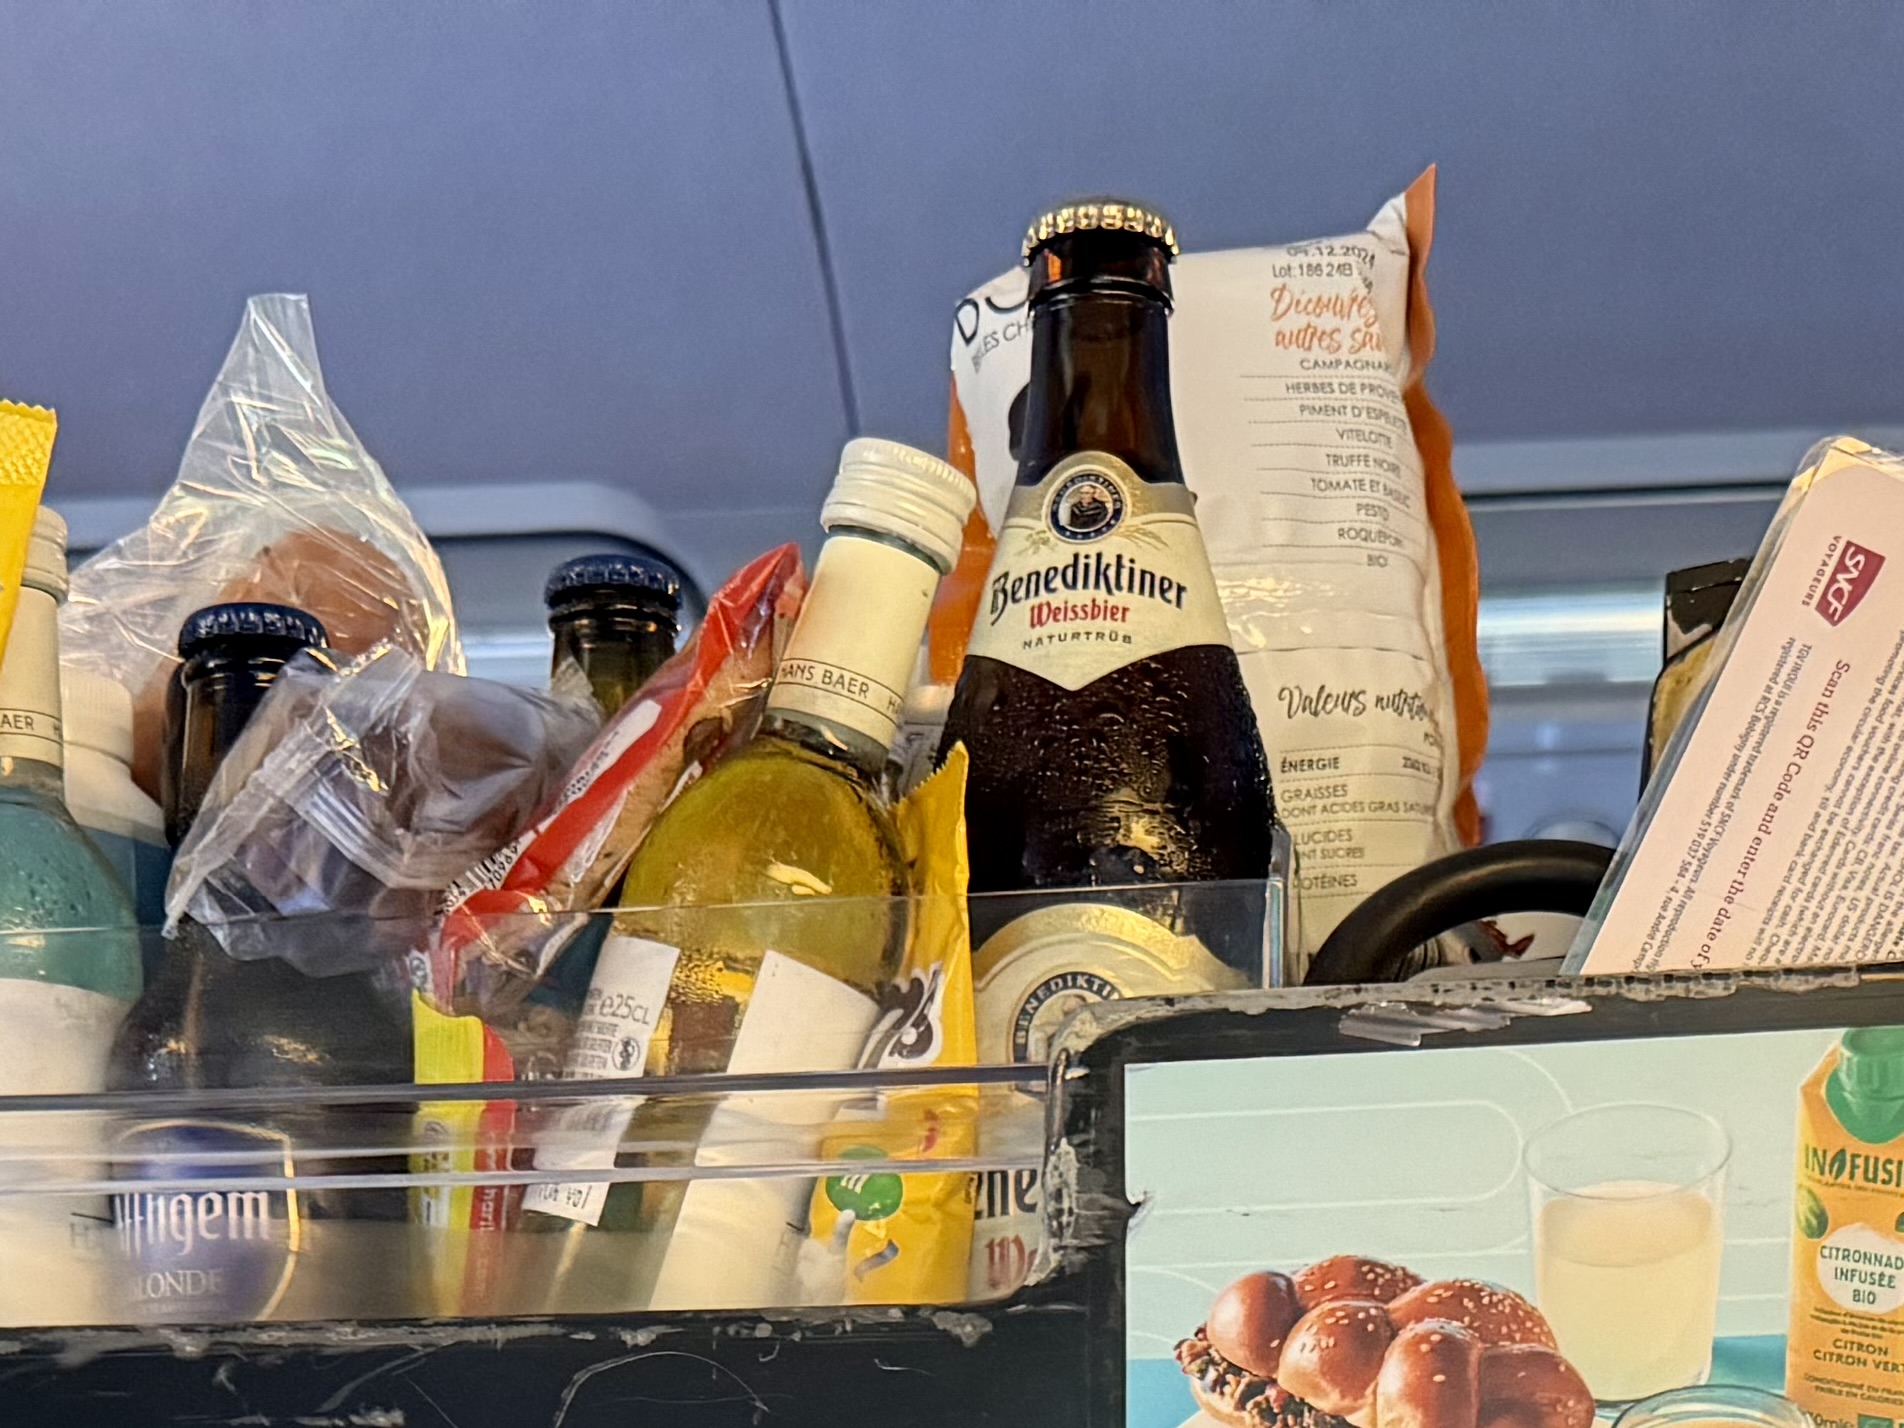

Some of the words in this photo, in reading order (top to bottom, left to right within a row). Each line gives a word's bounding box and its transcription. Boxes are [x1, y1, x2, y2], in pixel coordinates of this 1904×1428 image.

[1340, 382, 1356, 394] DE
[1311, 477, 1367, 492] TOMATE
[1798, 532, 1845, 608] VOYAGEURS
[1816, 544, 1872, 622] SNCF
[989, 551, 1188, 627] Benediktiner
[1028, 598, 1131, 630] Weissbier
[1022, 630, 1133, 650] NATURTRÜB
[821, 669, 870, 700] BAER
[1819, 658, 1852, 702] Scan
[1803, 699, 1832, 735] this
[1790, 731, 1816, 761] QR
[1280, 756, 1341, 775] ÉNERGIE
[1770, 759, 1802, 803] Code
[1755, 801, 1783, 836] and
[1734, 834, 1765, 878] enter
[1721, 877, 1746, 908] the
[1703, 908, 1732, 944] date
[1695, 941, 1716, 963] of
[1852, 1288, 1878, 1306] BIO
[1812, 1349, 1869, 1369] CITRON
[1831, 1337, 1890, 1358] CITRON
